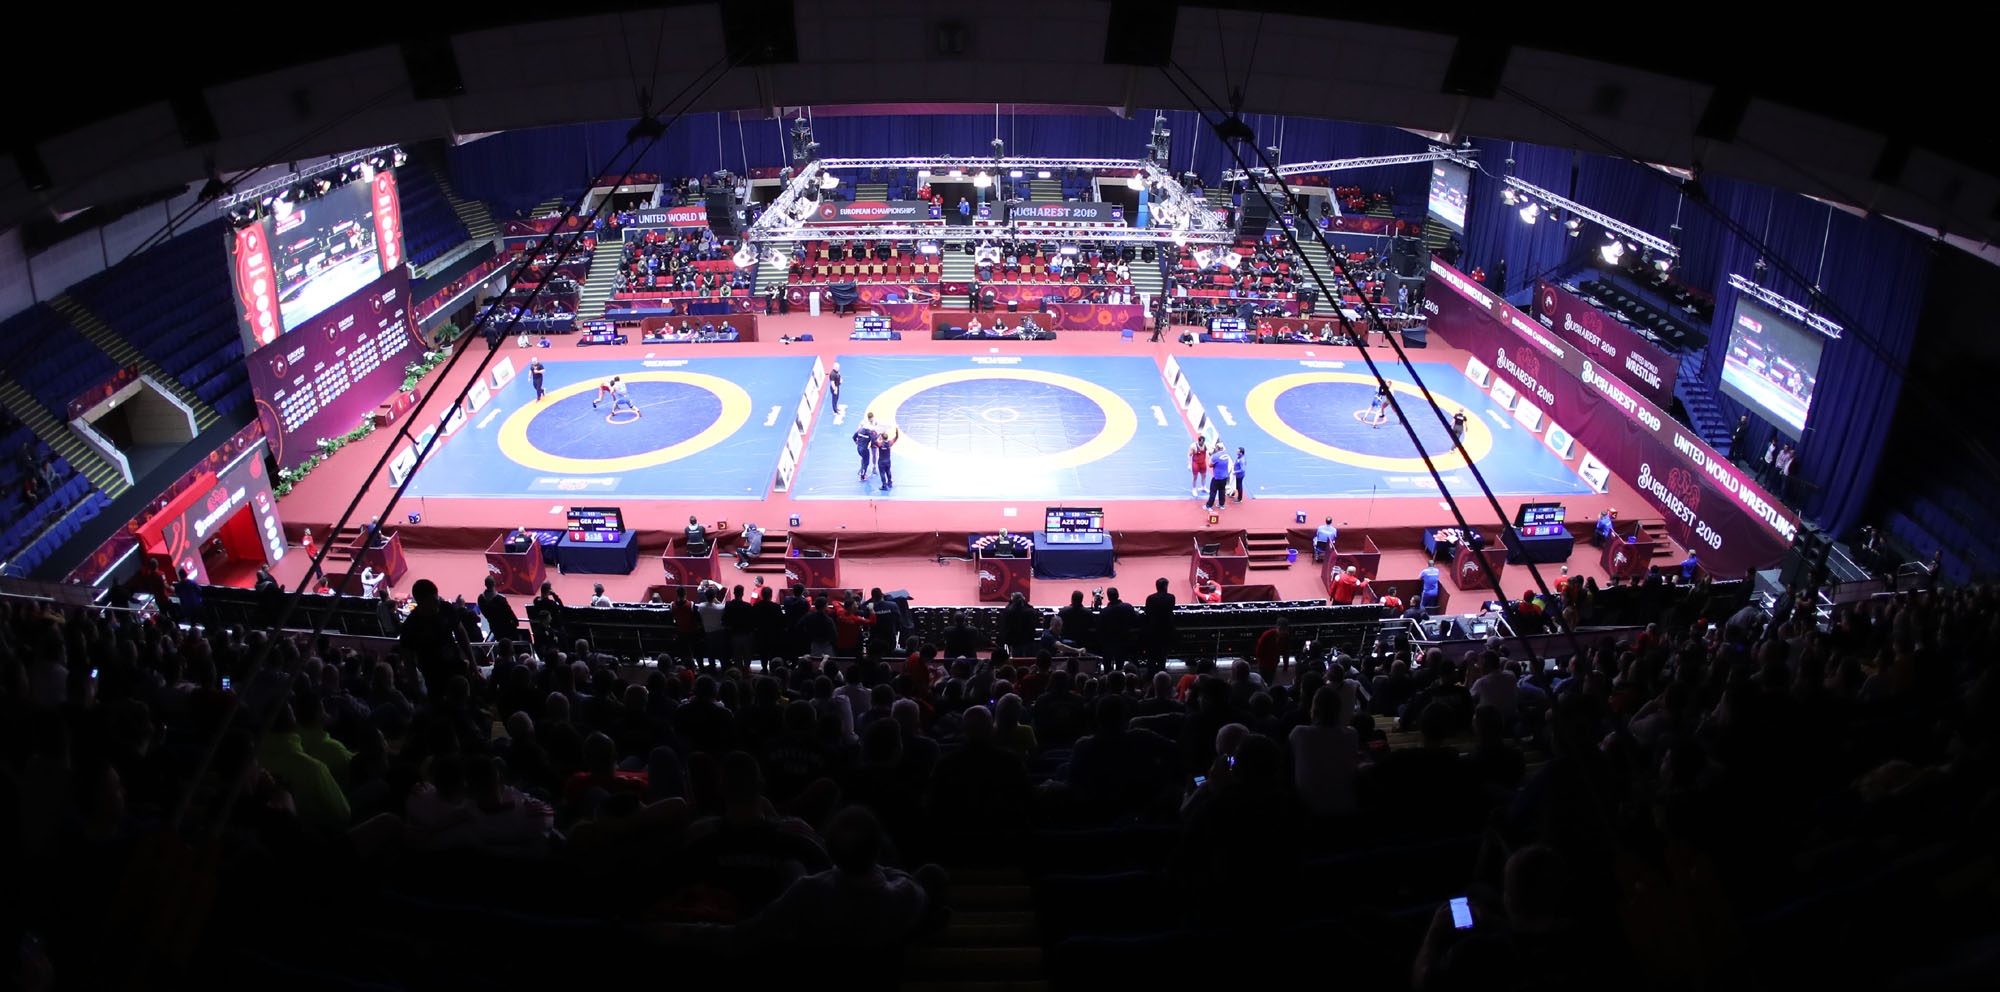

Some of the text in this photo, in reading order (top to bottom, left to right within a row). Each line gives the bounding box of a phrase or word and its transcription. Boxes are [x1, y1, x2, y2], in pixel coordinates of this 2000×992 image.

[638, 214, 666, 223] UNITED
[668, 212, 697, 222] WORLD
[1073, 208, 1097, 217] 2019
[1430, 260, 1494, 310] UNITED WORLD WRESTLING
[1511, 316, 1534, 336] EUROPEAN
[1532, 330, 1565, 359] CHAMPIONSHIPS
[1564, 313, 1602, 347] BUCHAREST
[1600, 341, 1616, 357] 2019
[1497, 347, 1537, 392] BUCHAREST
[1536, 385, 1554, 406] 2019
[1625, 356, 1661, 389] WRESTLING
[1631, 350, 1659, 375] UNITED WORLD
[1581, 360, 1638, 414] BUCHAREST
[1637, 407, 1661, 432] 2019
[1673, 432, 1797, 542] UNITED WORLD WRESTLING
[1637, 463, 1722, 550] BUCHAREST 2019
[574, 532, 580, 540] 0
[608, 533, 614, 541] 0
[1052, 534, 1058, 542] 0
[1069, 533, 1079, 542] 11
[1554, 526, 1559, 534] 0
